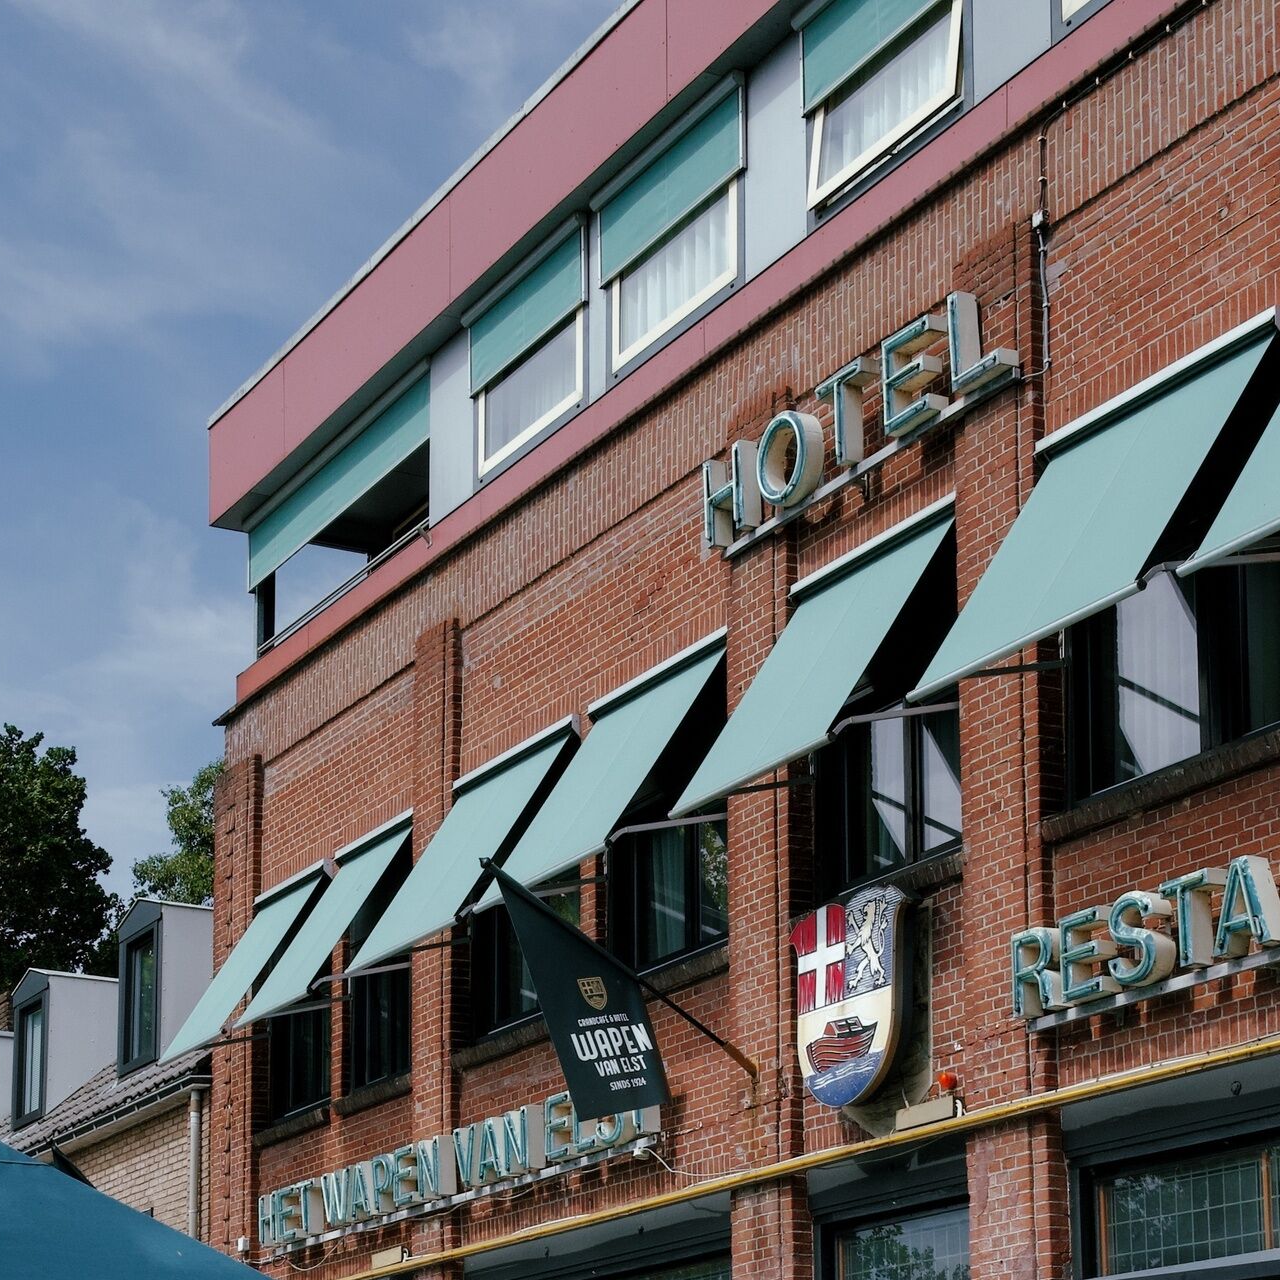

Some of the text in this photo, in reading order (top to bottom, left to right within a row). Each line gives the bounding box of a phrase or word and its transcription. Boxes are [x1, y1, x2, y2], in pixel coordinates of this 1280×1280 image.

[702, 291, 1020, 549] HOTEL
[613, 1013, 630, 1022] HOTEL
[570, 1023, 654, 1062] WAPEN
[594, 1055, 647, 1077] VAN ELST
[609, 1077, 647, 1091] SINDS 1924
[257, 1176, 324, 1246] HET
[321, 1135, 457, 1228] WAPEN
[452, 1104, 546, 1187] VAN
